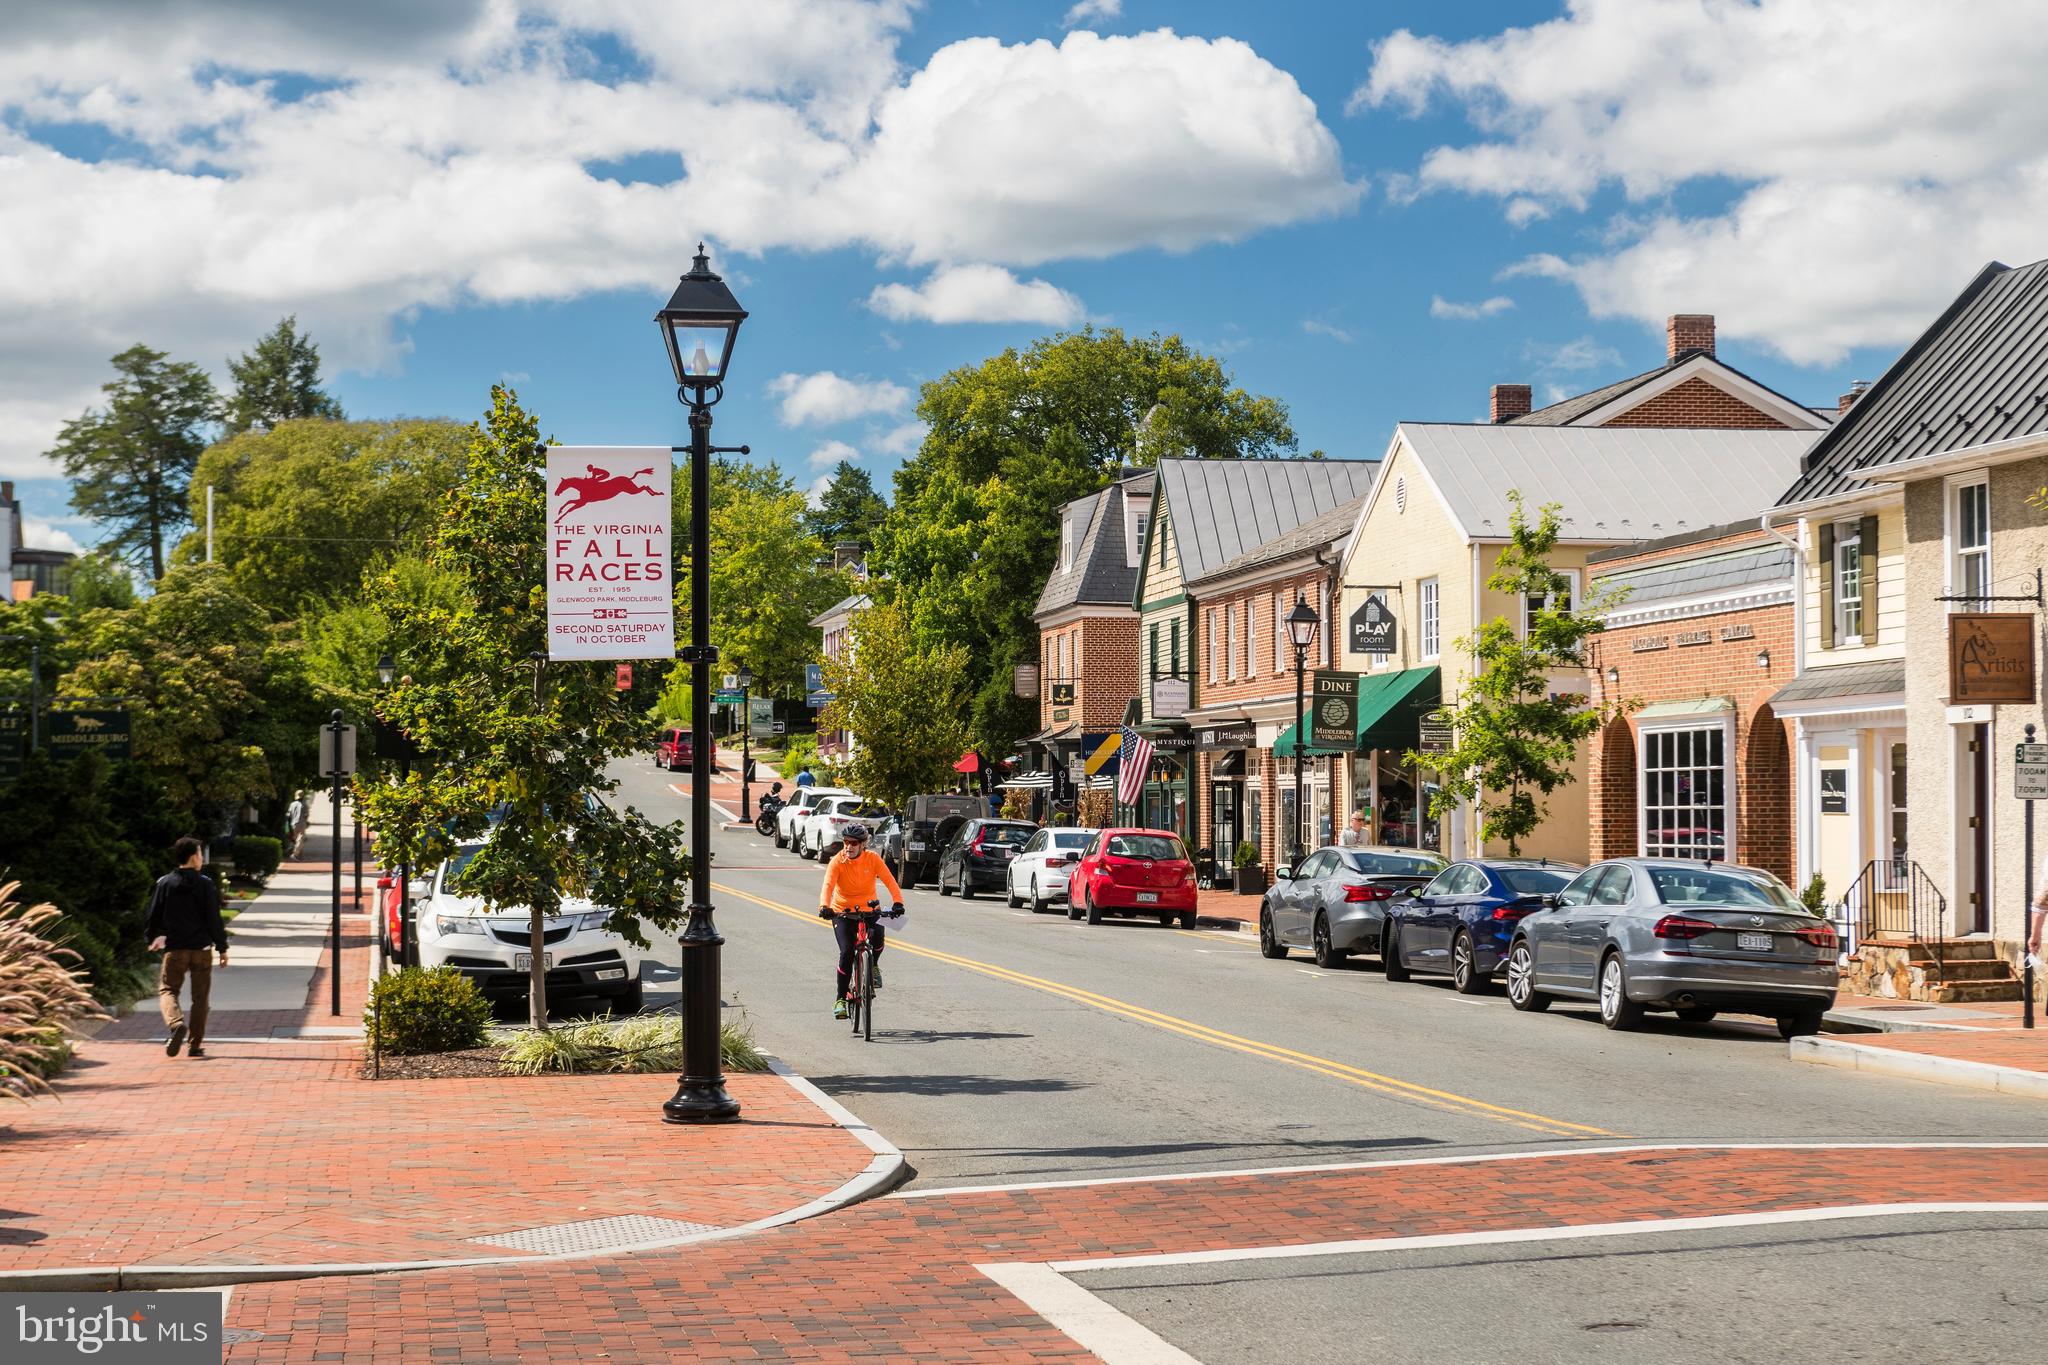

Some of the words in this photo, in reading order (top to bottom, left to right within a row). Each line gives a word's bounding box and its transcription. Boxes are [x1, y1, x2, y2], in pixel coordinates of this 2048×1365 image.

[555, 525, 586, 535] THE
[594, 525, 663, 535] VIRGINIA
[556, 539, 663, 558] FALL
[556, 563, 663, 581] RACES
[618, 595, 663, 603] MIDDLEBURG
[555, 624, 604, 634] SECOND
[606, 623, 666, 634] SATURDAY
[1355, 621, 1392, 636] PLAY
[576, 635, 588, 644] IN
[590, 634, 647, 644] OCTOBER
[1359, 636, 1385, 644] room
[1321, 680, 1352, 692] DINE
[1315, 727, 1354, 736] MIDDLEBURG
[1321, 733, 1348, 741] VIRGINIA
[51, 733, 129, 744] MIDDLEBURG
[2016, 747, 2024, 760] 3
